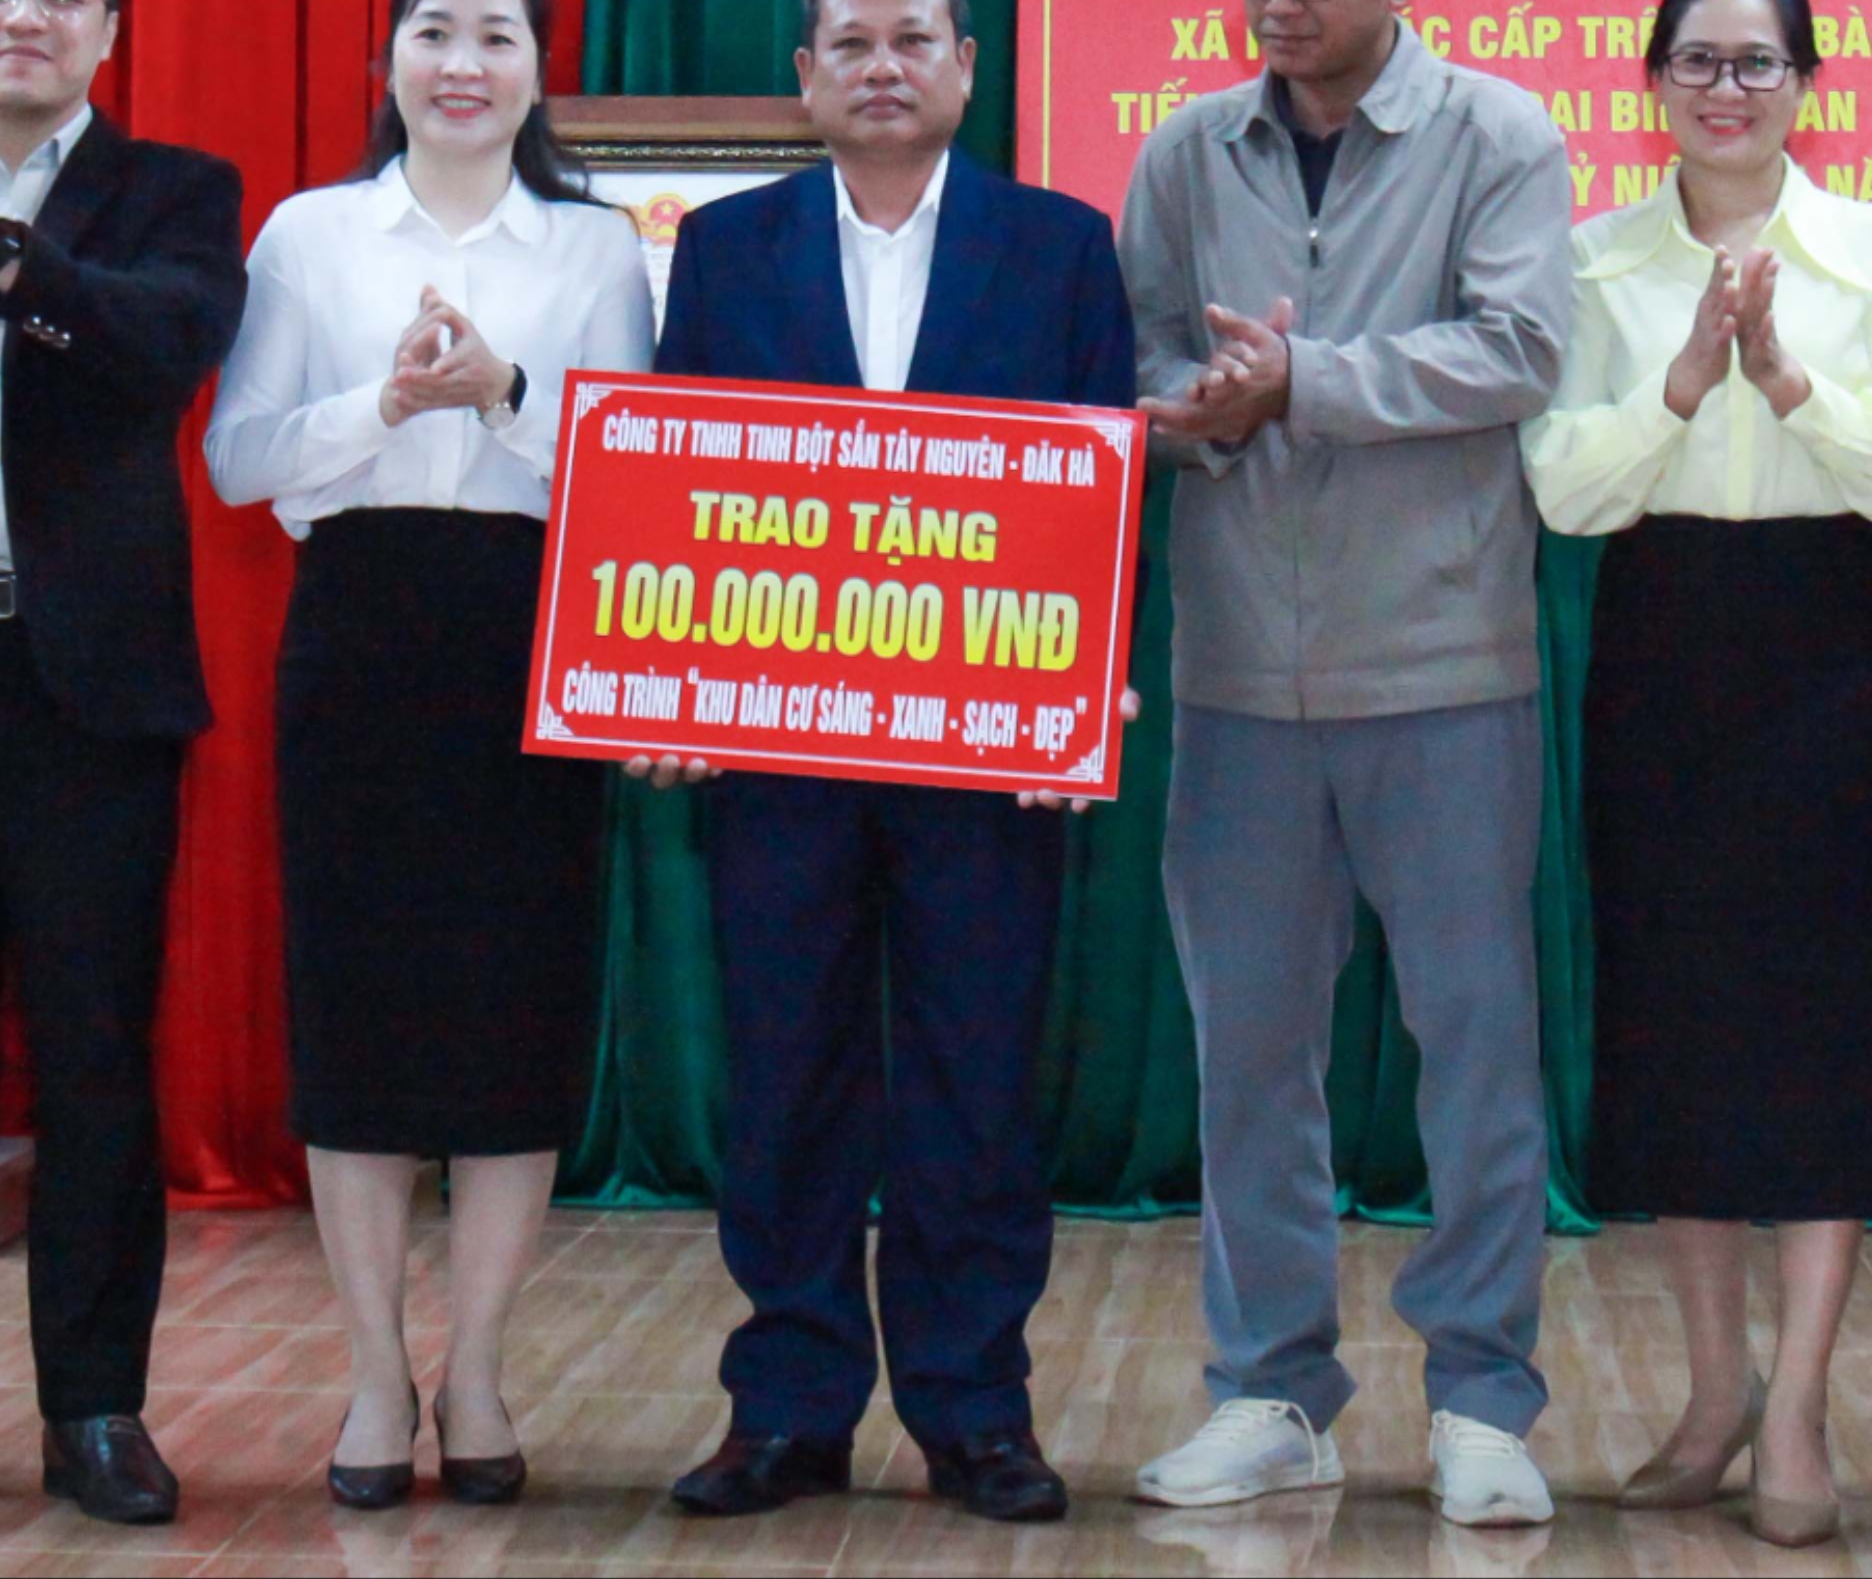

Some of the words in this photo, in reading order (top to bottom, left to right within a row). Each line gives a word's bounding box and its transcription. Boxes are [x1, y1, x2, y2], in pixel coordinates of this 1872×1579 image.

[1171, 8, 1230, 60] XÃ
[1469, 1, 1563, 59] CẤP
[602, 407, 658, 454] CÔNG
[662, 417, 687, 456] TY
[690, 420, 743, 460] TNHH
[747, 423, 793, 463] TINH
[794, 420, 835, 473] BỘT
[885, 426, 922, 473] TÂY
[924, 434, 1005, 481] NGUYÊN
[1066, 441, 1096, 488] HÀ
[690, 490, 829, 549] TRAO
[849, 494, 998, 566] TẶNG
[592, 559, 943, 662] 100.000.000
[963, 586, 1080, 672] VNĐ
[562, 659, 618, 717] CÔNG
[622, 665, 682, 721] TRÌNH
[738, 674, 783, 729] DÂN
[785, 683, 820, 733] CƯ
[817, 680, 874, 736] SÁNG
[889, 694, 946, 742] XANH
[962, 699, 1018, 757] SẠCH
